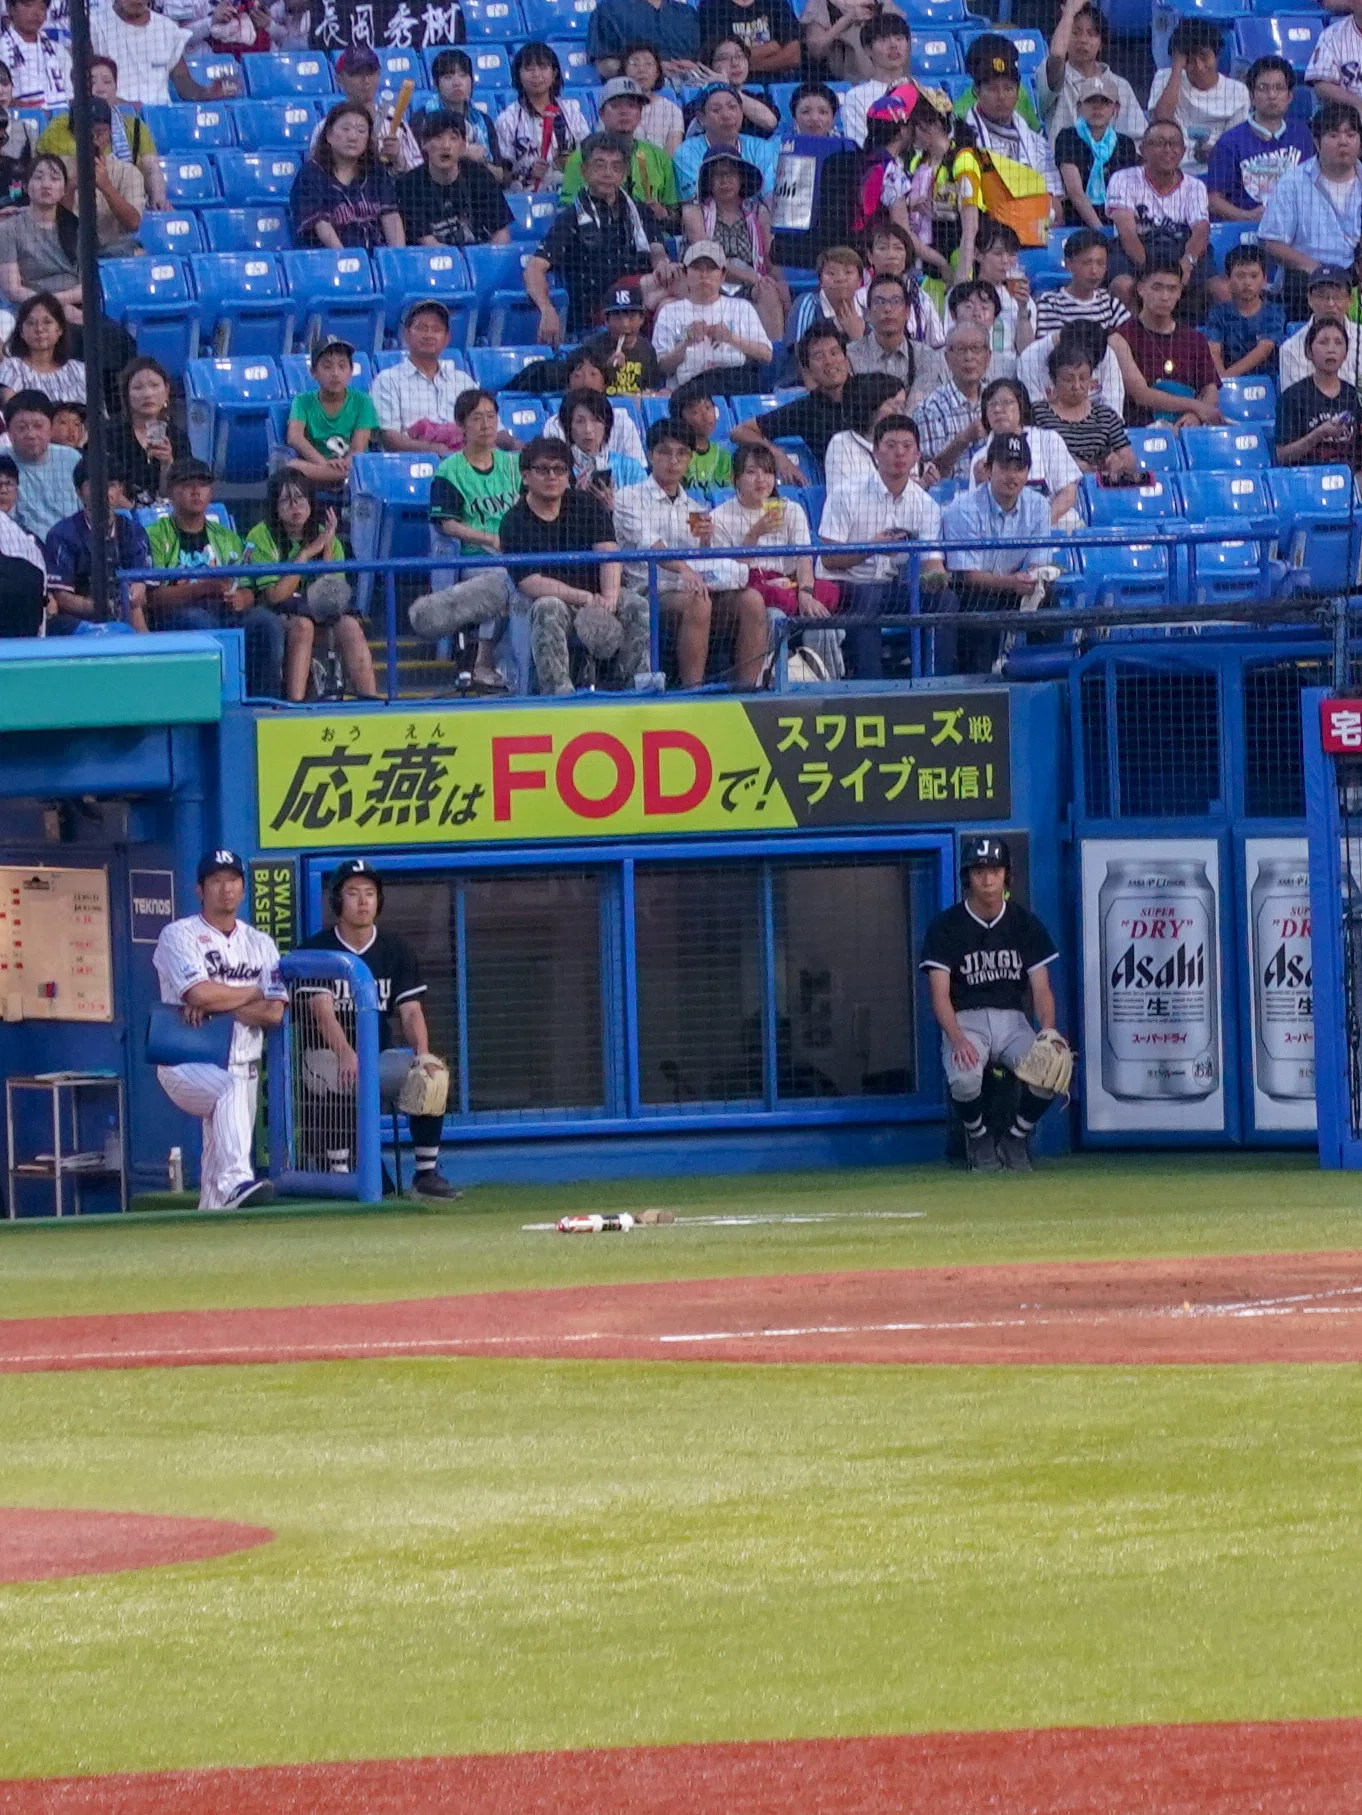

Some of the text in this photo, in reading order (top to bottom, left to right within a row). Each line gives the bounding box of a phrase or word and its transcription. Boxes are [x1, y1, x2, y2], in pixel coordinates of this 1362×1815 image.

[776, 707, 993, 752] スワローズ戦
[798, 755, 995, 805] ライブ配信!
[1140, 906, 1175, 918] SUPER
[960, 950, 1023, 975] JINGU
[1111, 942, 1204, 989] Asahi
[966, 968, 1021, 985] STADIUM
[1147, 997, 1170, 1016] 生
